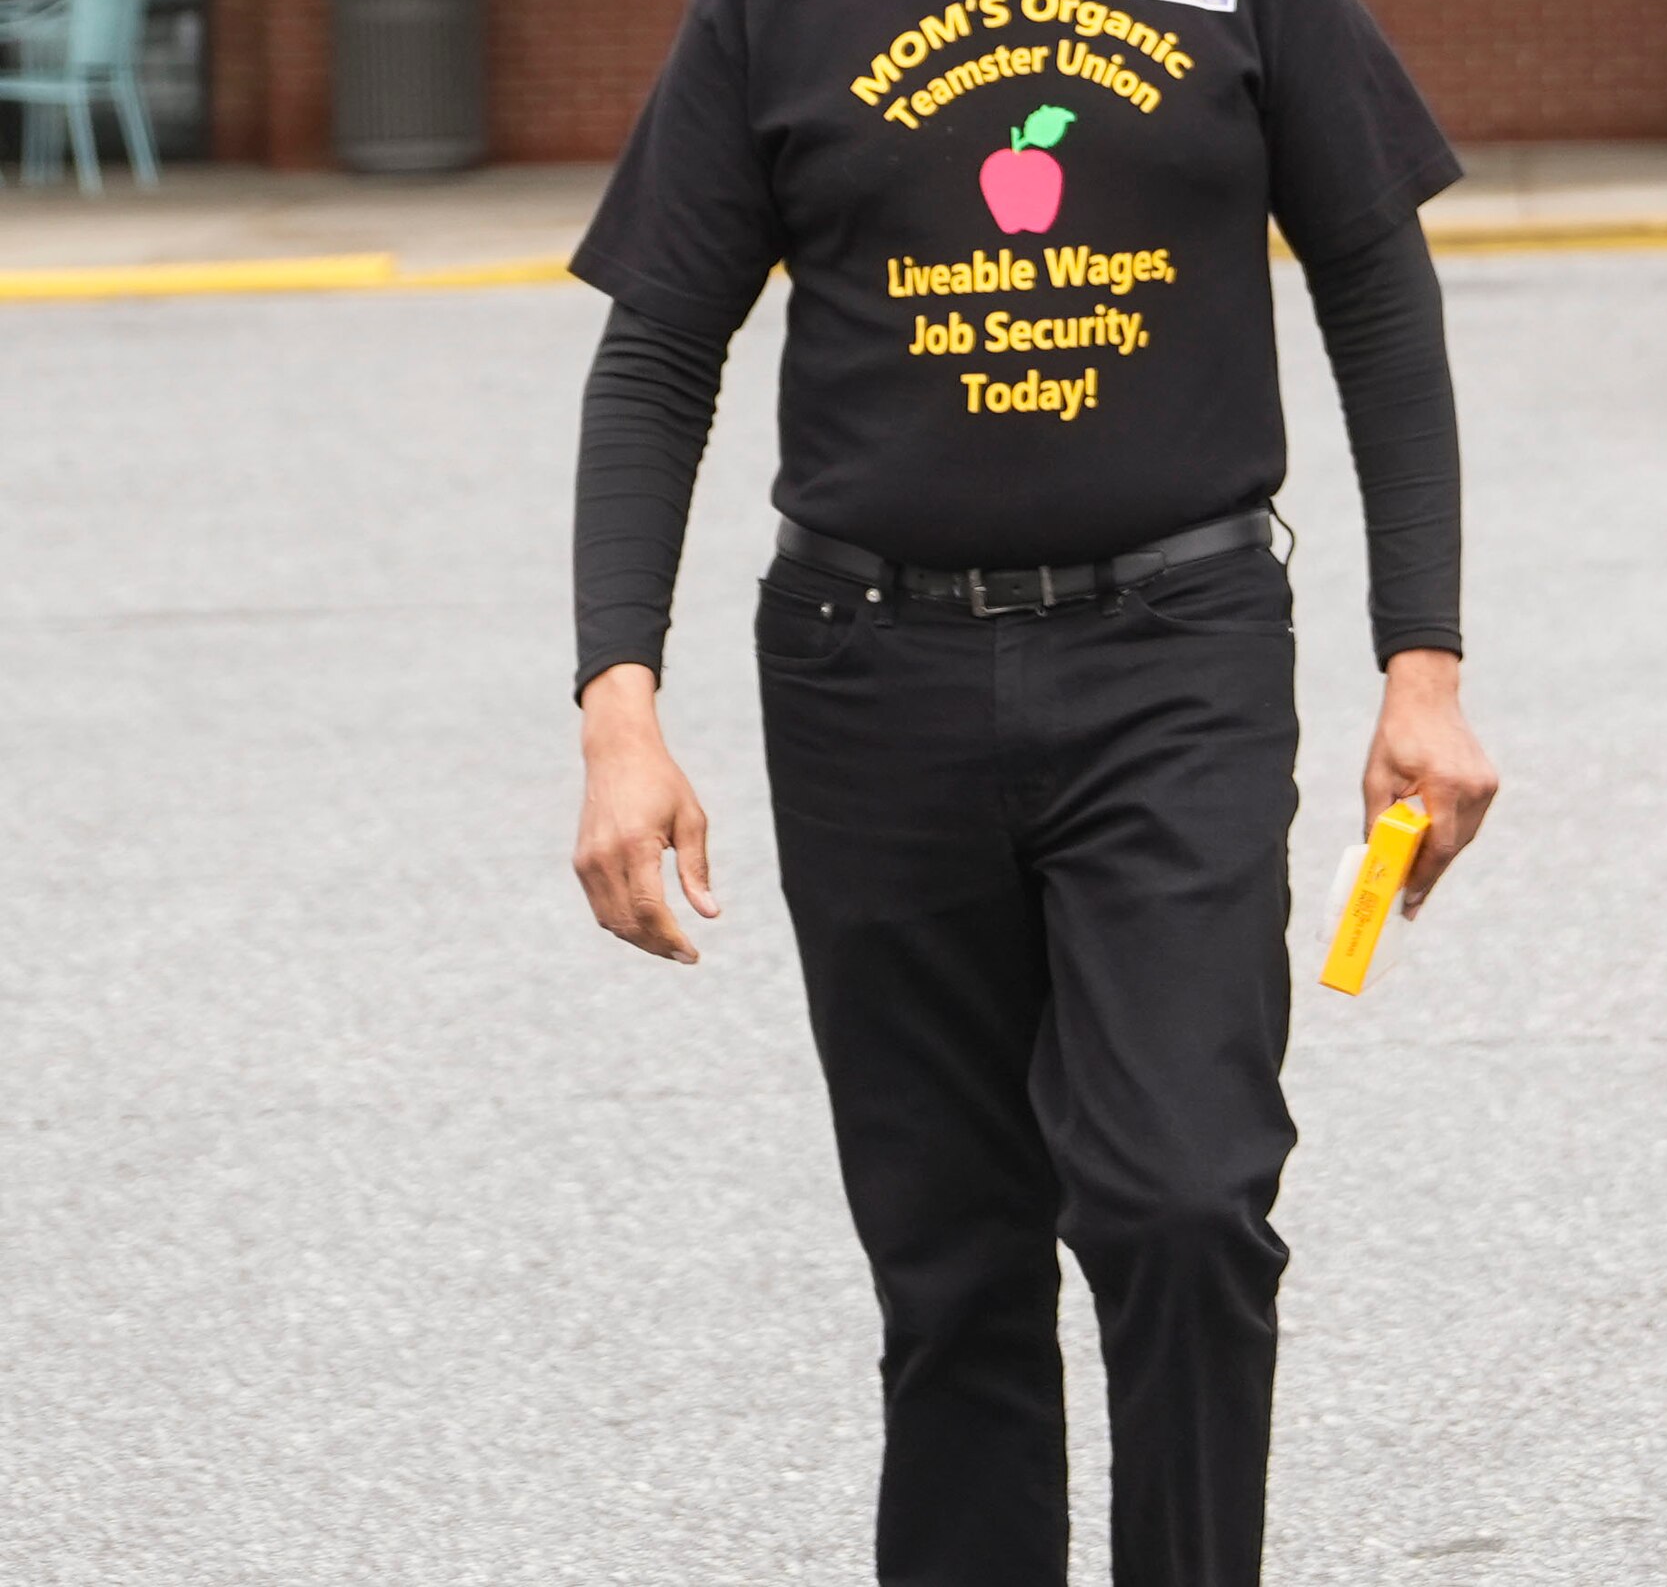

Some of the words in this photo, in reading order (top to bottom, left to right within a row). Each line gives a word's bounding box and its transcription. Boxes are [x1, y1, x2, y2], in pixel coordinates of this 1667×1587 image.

[884, 44, 1050, 130] Teamster
[1056, 39, 1162, 113] Union
[887, 249, 1037, 298] Liveable
[1043, 245, 1177, 295] Wages,
[909, 312, 975, 356] Job
[984, 304, 1150, 356] Security,
[960, 368, 1099, 422] Today!
